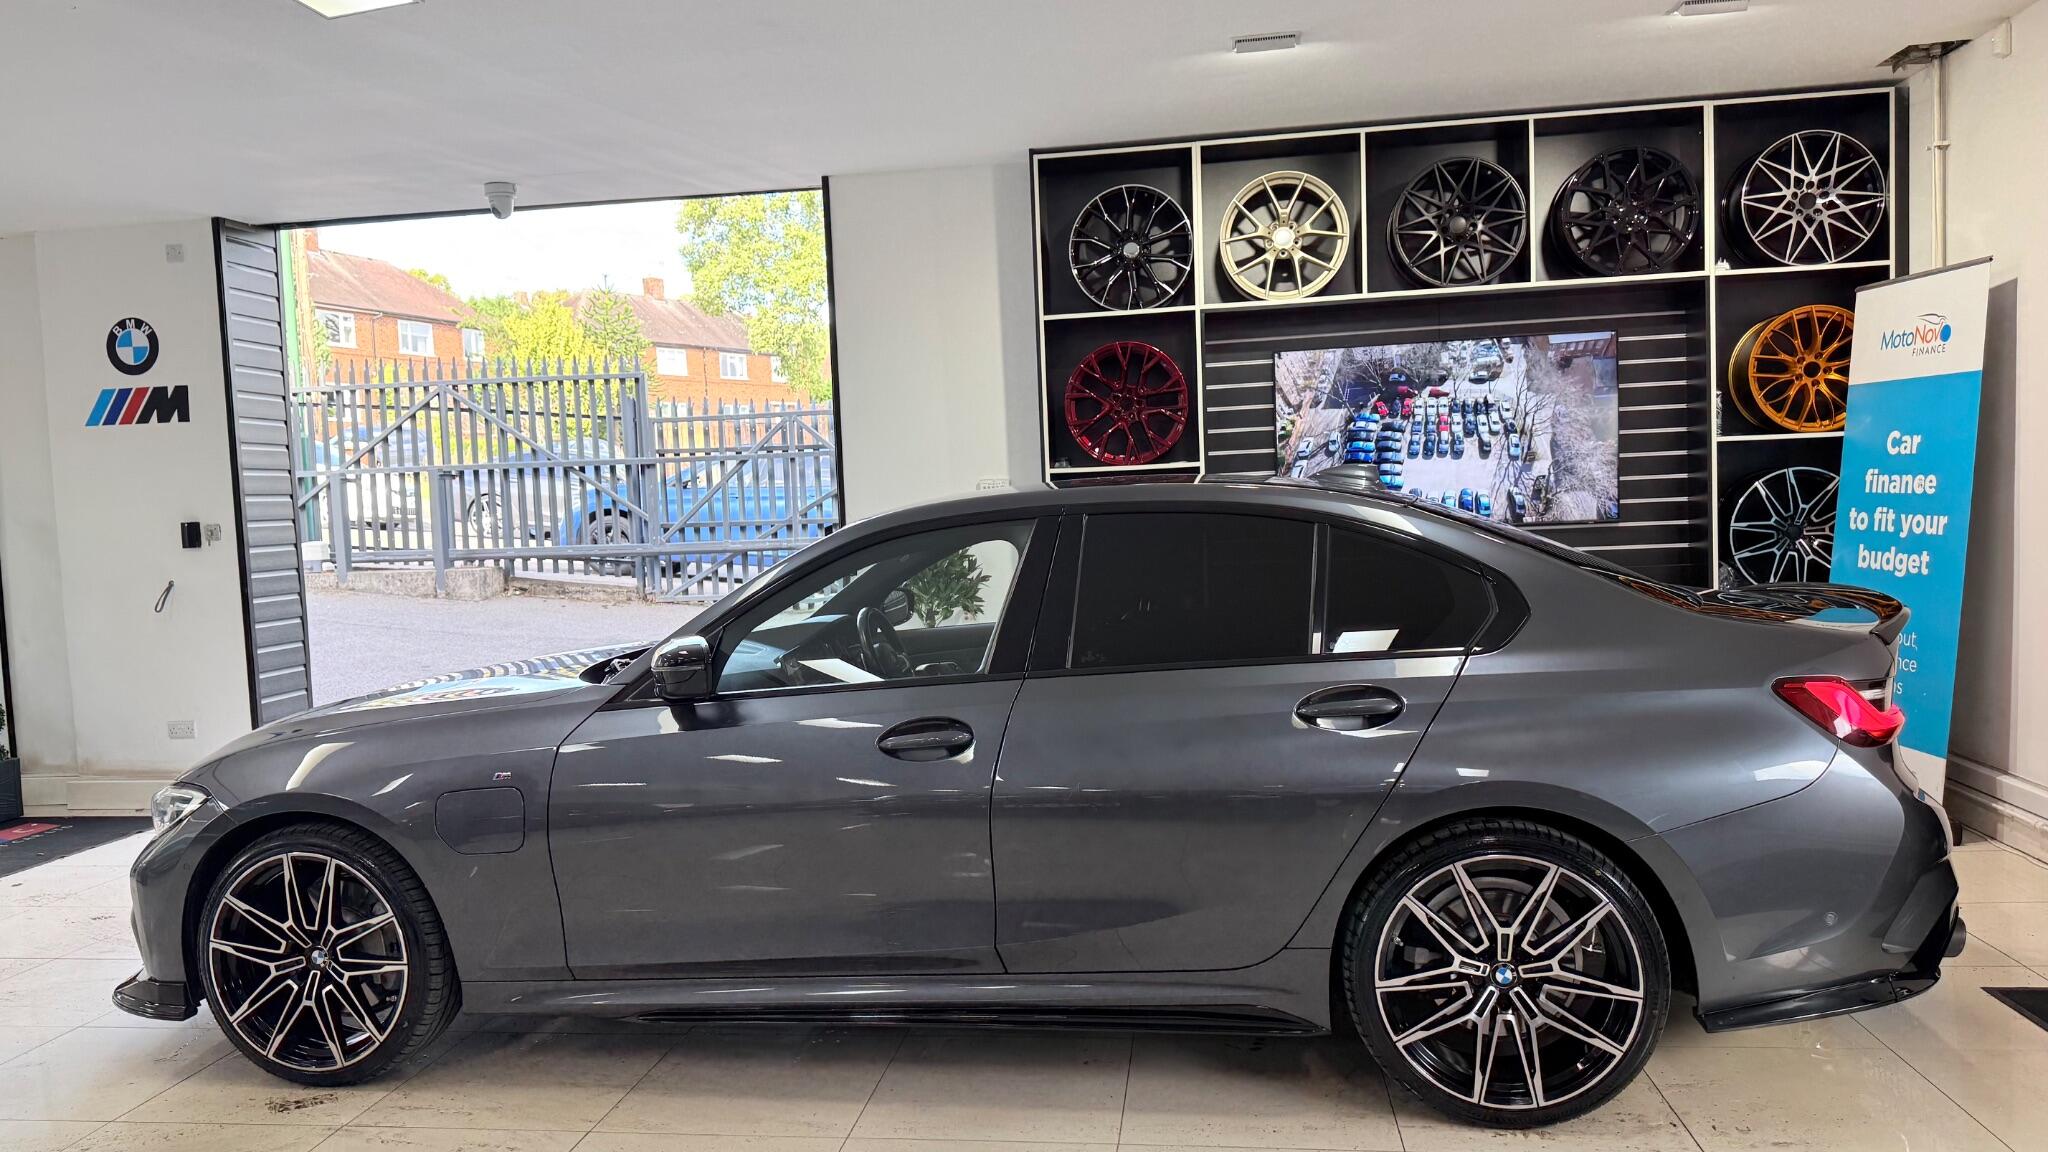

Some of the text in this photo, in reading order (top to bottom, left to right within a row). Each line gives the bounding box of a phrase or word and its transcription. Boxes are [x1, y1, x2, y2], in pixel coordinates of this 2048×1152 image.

[112, 319, 153, 336] BMW
[1912, 344, 1946, 357] FINANCE
[1886, 430, 1922, 455] Car
[1864, 468, 1937, 494] finance
[1849, 506, 1948, 538] to fit your
[1857, 543, 1930, 578] budget
